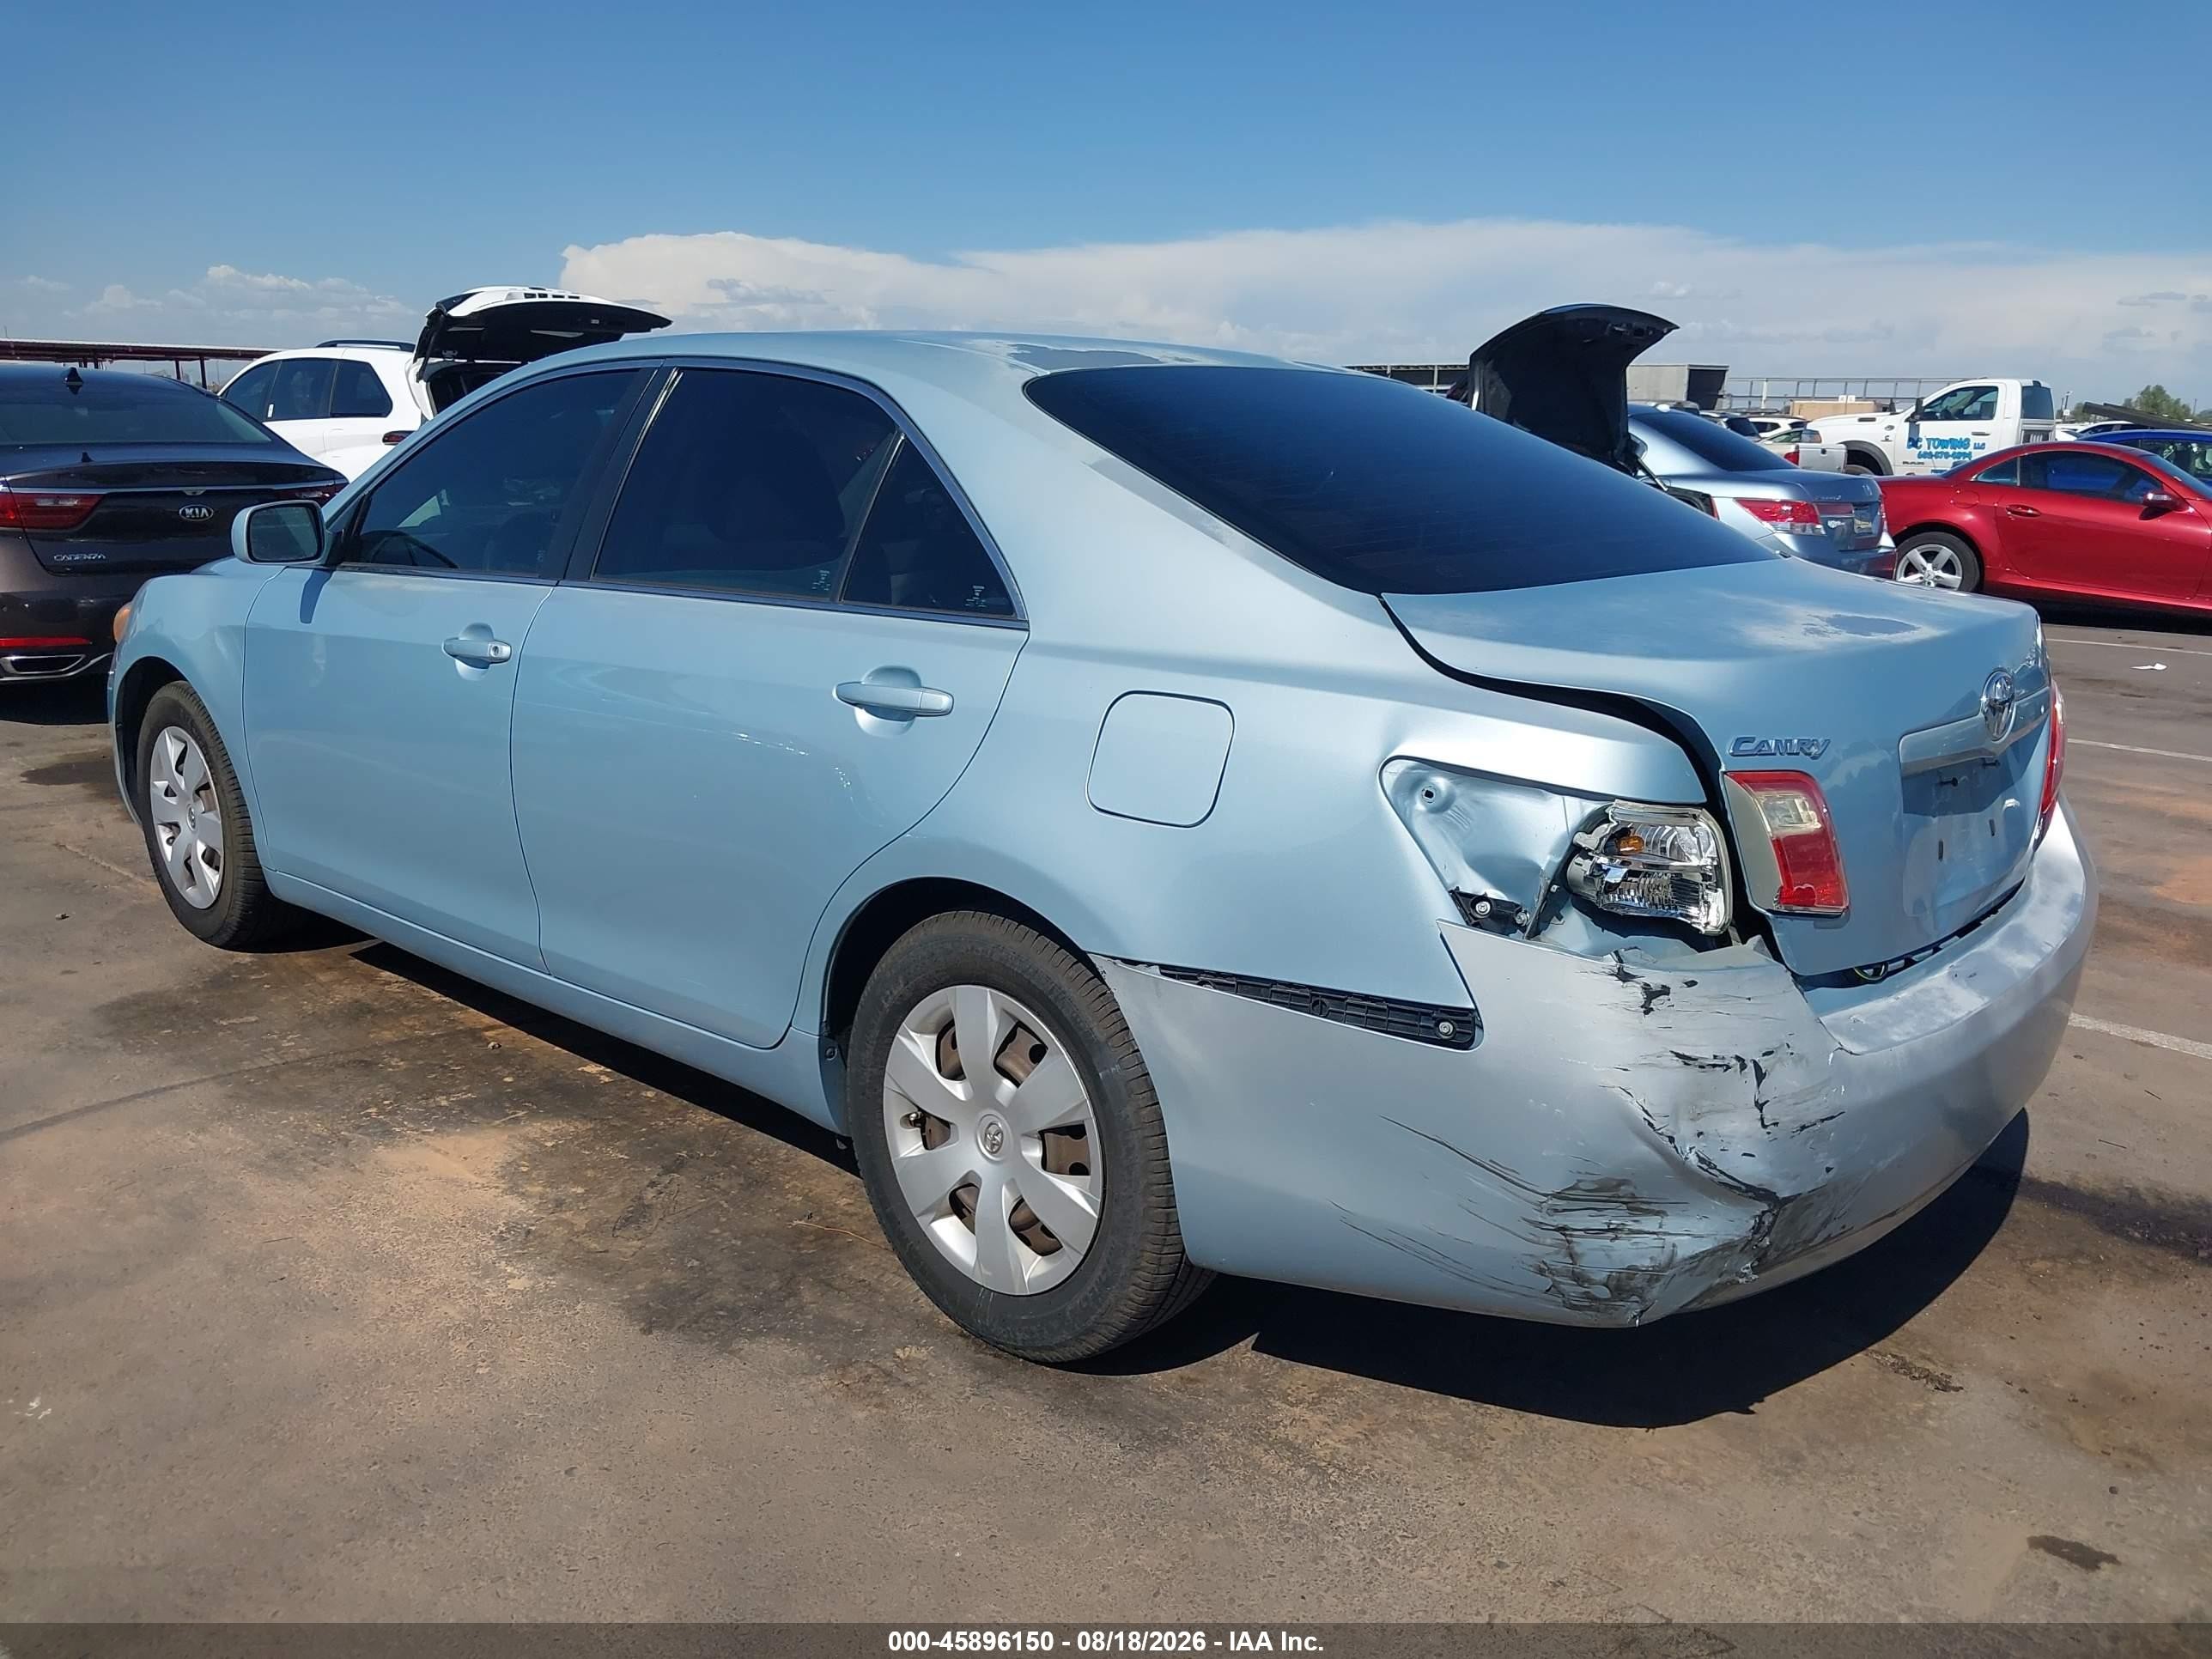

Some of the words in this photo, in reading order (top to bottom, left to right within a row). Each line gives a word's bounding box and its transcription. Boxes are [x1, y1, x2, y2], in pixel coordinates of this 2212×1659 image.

[1926, 437, 1971, 450] TOWING
[184, 507, 210, 520] KIA
[53, 553, 106, 562] CADENZA
